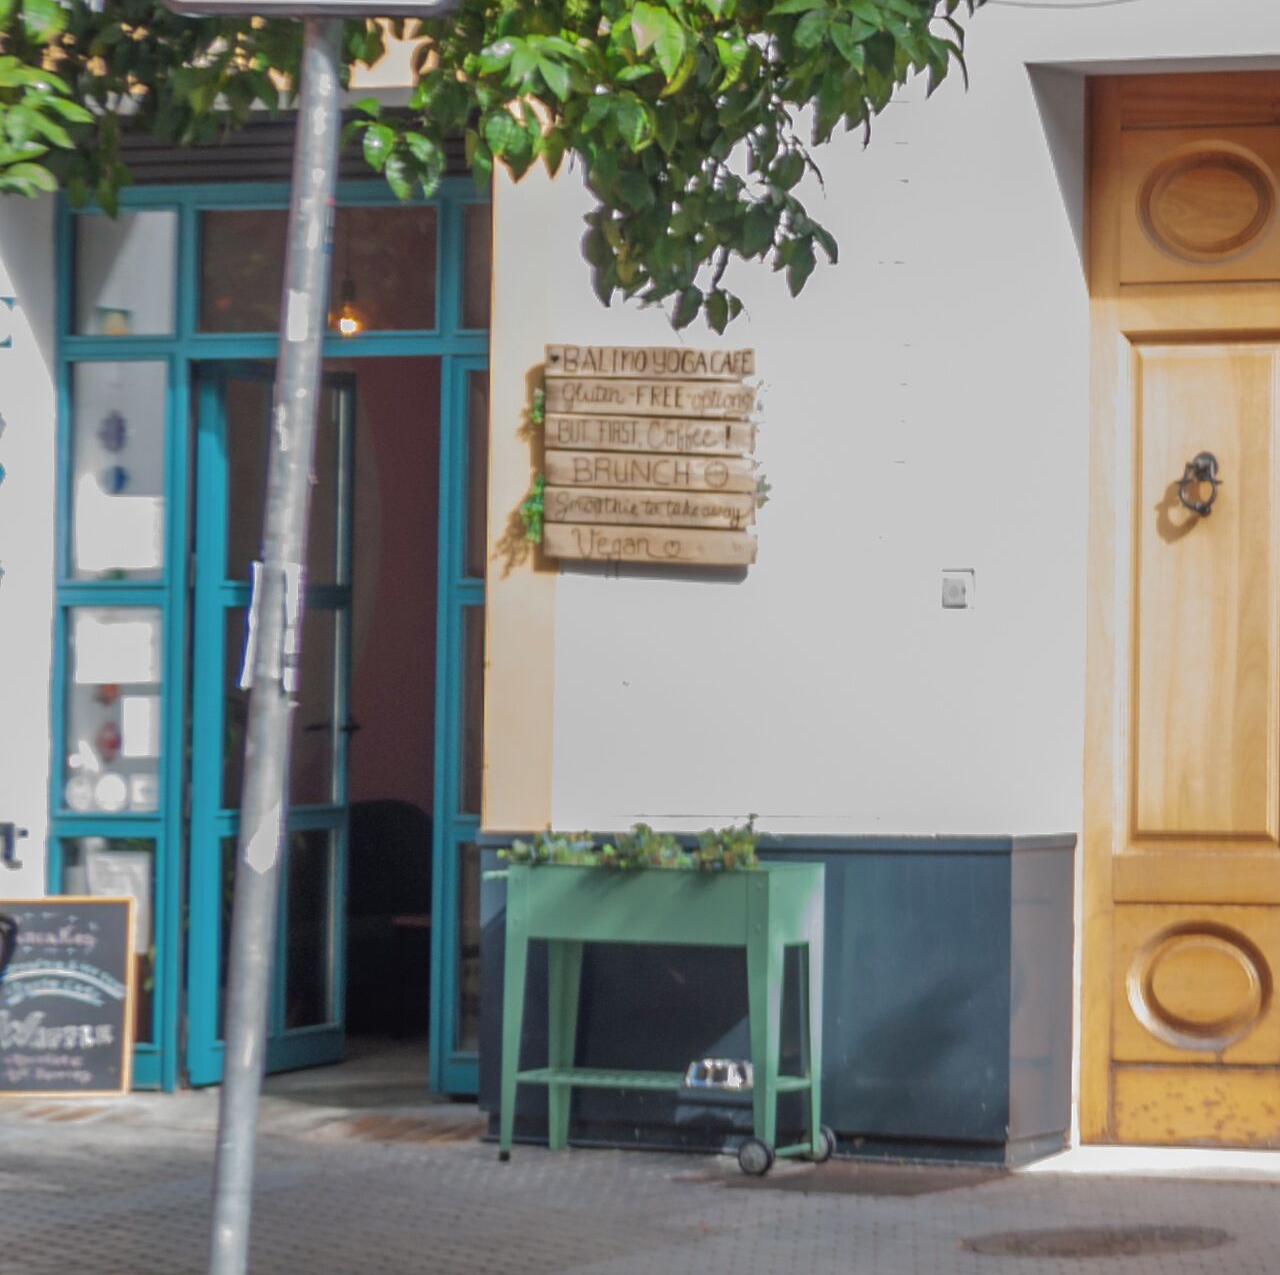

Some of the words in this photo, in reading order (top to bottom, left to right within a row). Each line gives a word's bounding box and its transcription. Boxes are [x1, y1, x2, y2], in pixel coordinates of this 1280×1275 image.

[710, 349, 753, 373] CAFE
[558, 419, 588, 444] BUT
[572, 456, 691, 486] BRUNCH
[571, 527, 652, 562] Vegan
